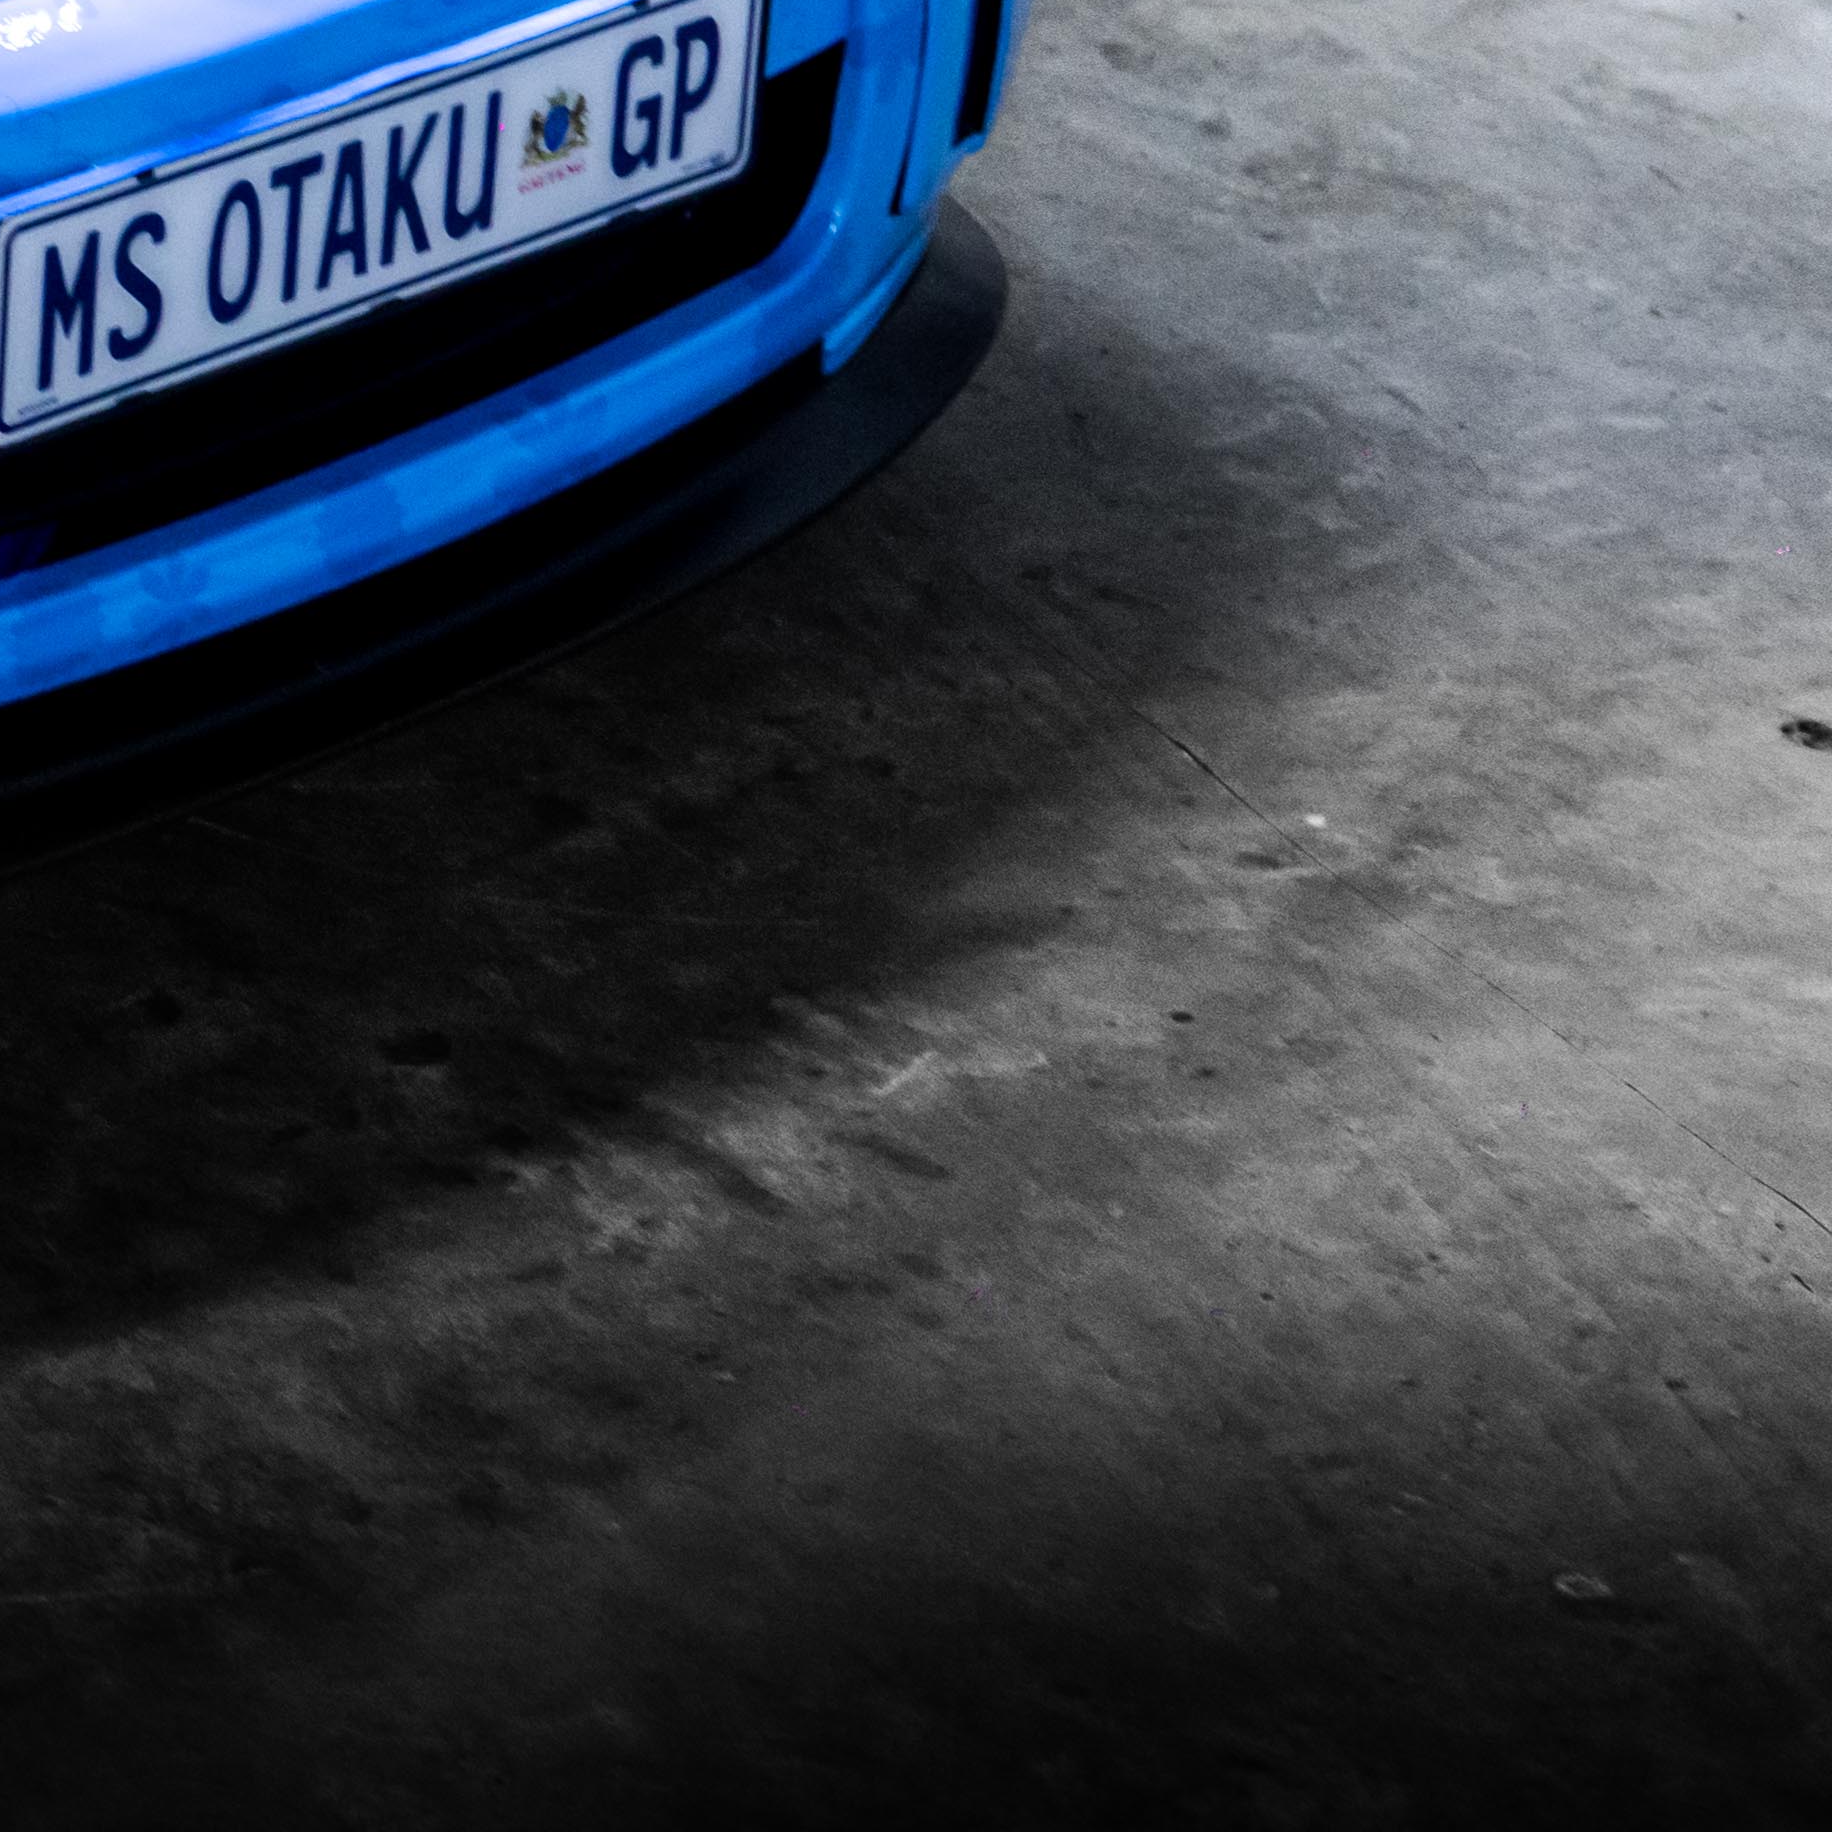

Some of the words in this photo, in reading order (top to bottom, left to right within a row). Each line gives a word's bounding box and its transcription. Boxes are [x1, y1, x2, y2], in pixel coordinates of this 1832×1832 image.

[37, 211, 167, 393] MS
[207, 89, 503, 325] OTAKU
[609, 14, 721, 180] GP
